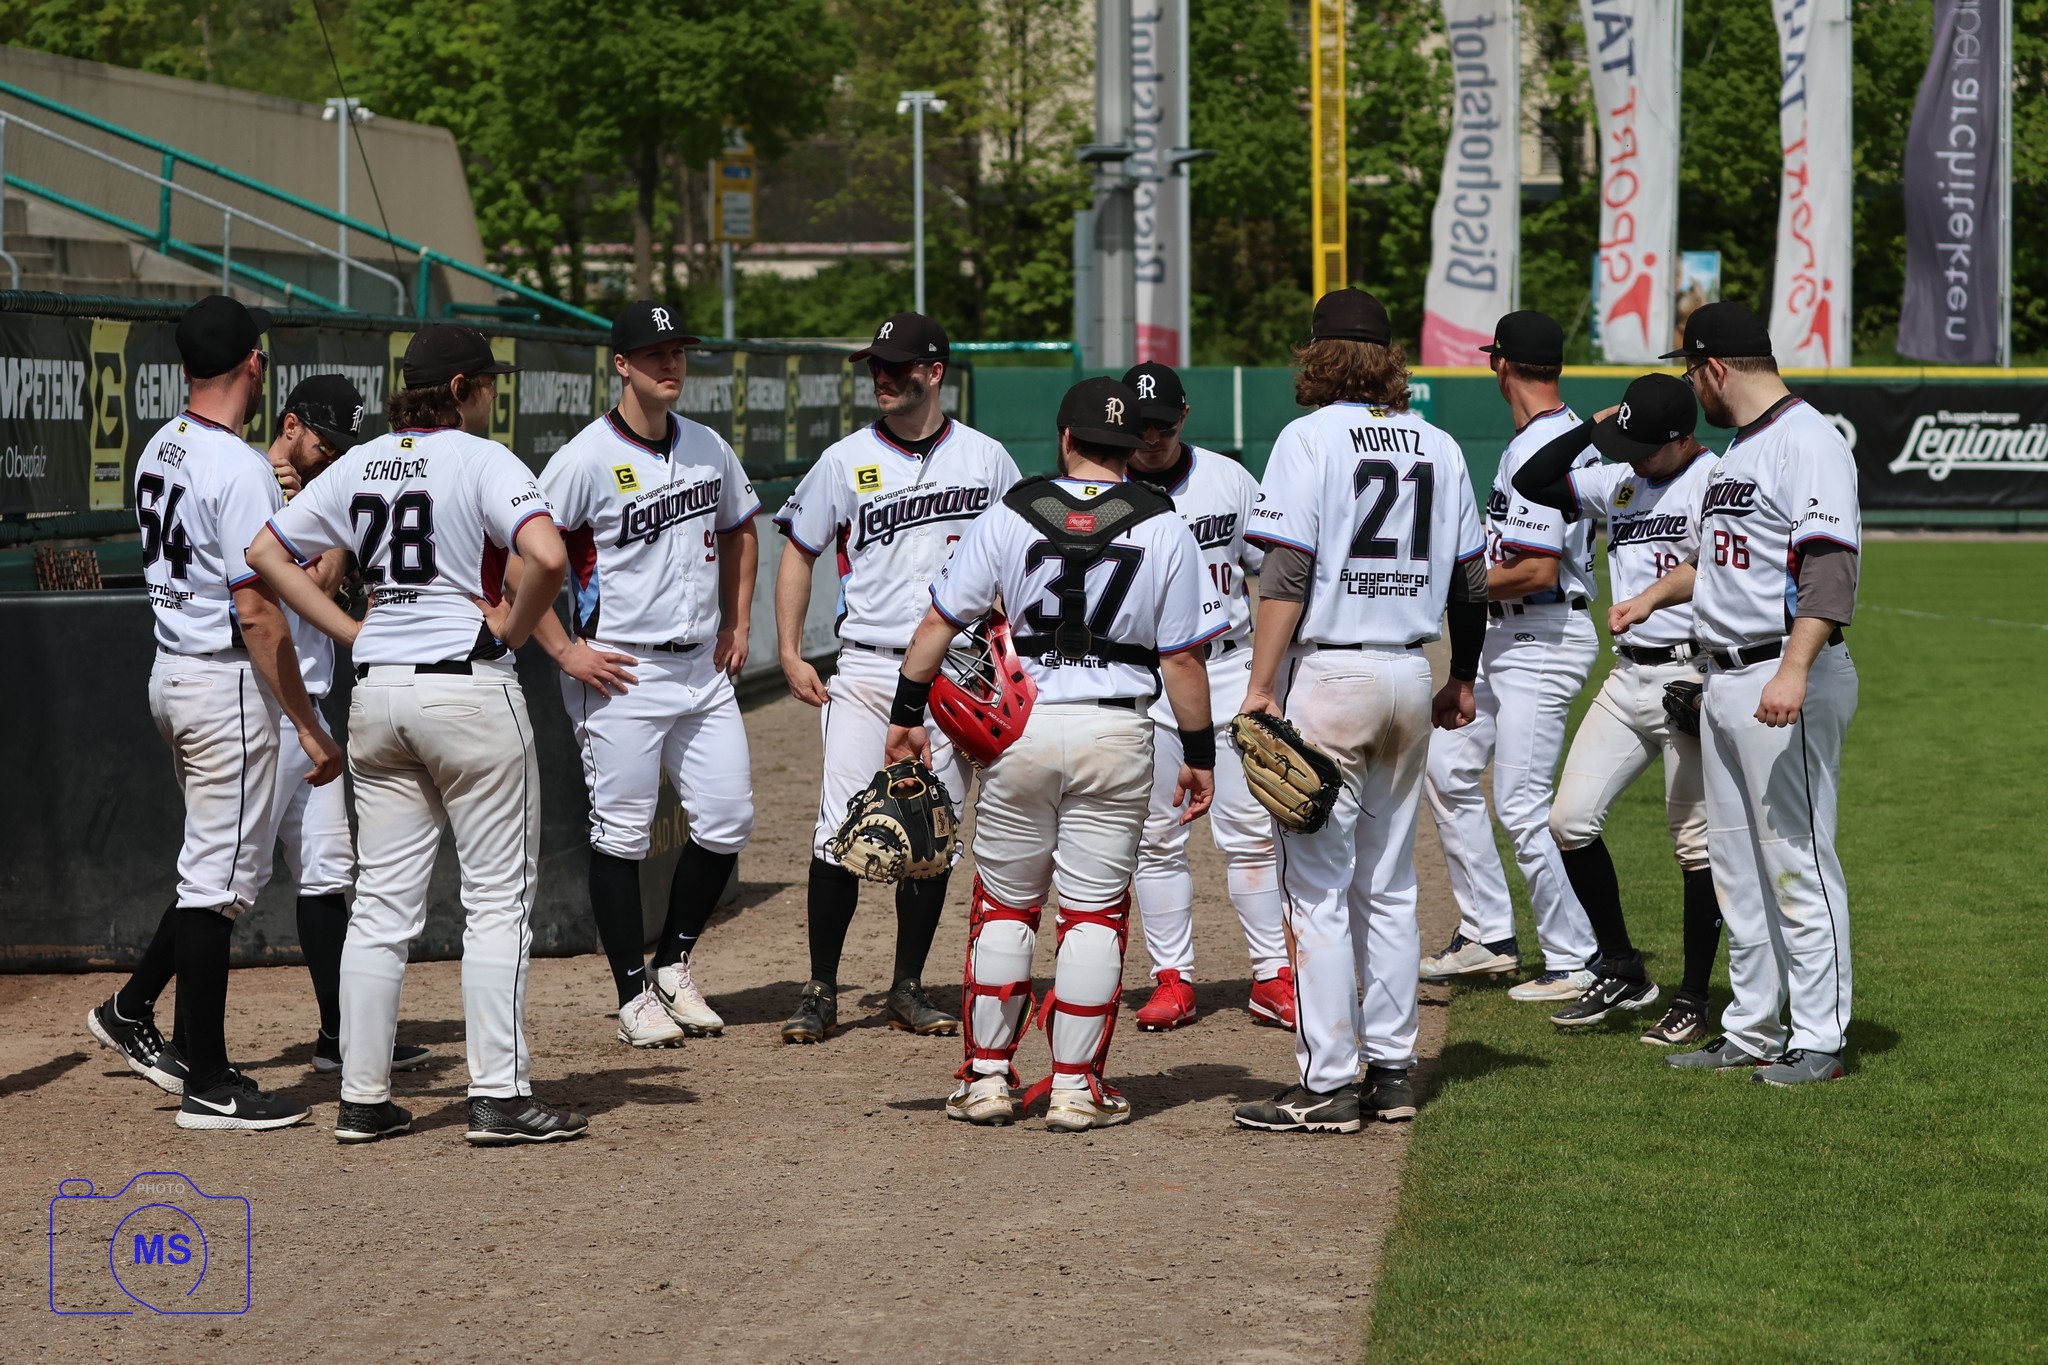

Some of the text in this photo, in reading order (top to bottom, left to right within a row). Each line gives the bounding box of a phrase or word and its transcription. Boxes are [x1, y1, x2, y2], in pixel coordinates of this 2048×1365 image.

[5, 446, 47, 480] Oberpfalz
[156, 441, 187, 470] WEBER
[1349, 426, 1426, 457] MORITZ
[1888, 414, 2048, 482] Legionä
[614, 478, 722, 550] Legionäre
[635, 478, 686, 503] Guggenberger
[853, 485, 990, 552] Legionäre
[1350, 458, 1436, 562] 21
[349, 490, 439, 586] 28
[1713, 529, 1751, 571] 86
[1024, 538, 1146, 638] 37
